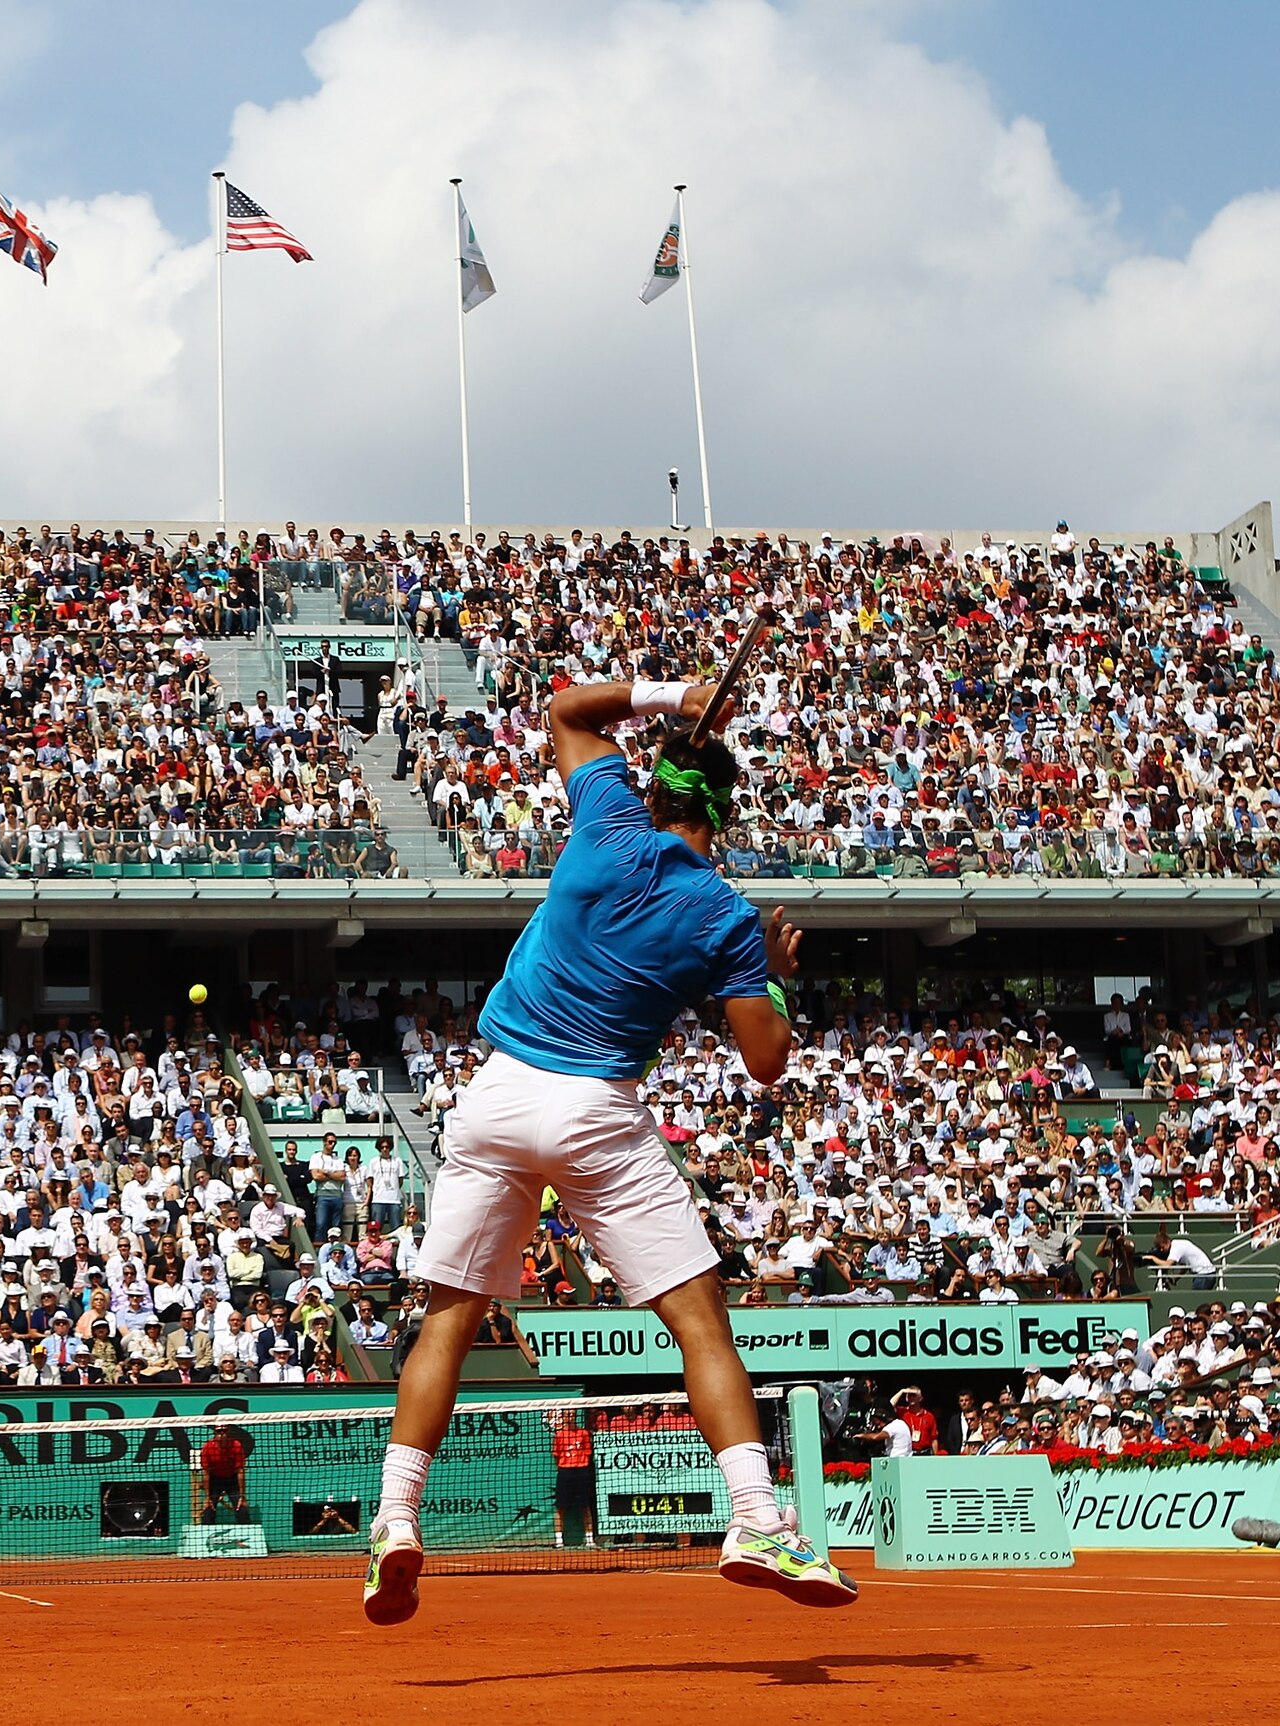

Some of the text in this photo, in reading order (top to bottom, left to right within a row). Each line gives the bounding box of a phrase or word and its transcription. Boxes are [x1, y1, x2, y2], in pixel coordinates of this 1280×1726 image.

[338, 642, 385, 657] FedEx
[525, 1330, 644, 1357] AFFLELOU
[734, 1330, 804, 1352] sport
[847, 1318, 1005, 1357] adidas
[9, 1502, 94, 1522] PARIBAS
[631, 1495, 685, 1515] 0:41
[926, 1488, 1036, 1534] IBM
[1072, 1490, 1246, 1530] PEUGEOT
[906, 1551, 1072, 1562] ROLANDGARROS.COM
